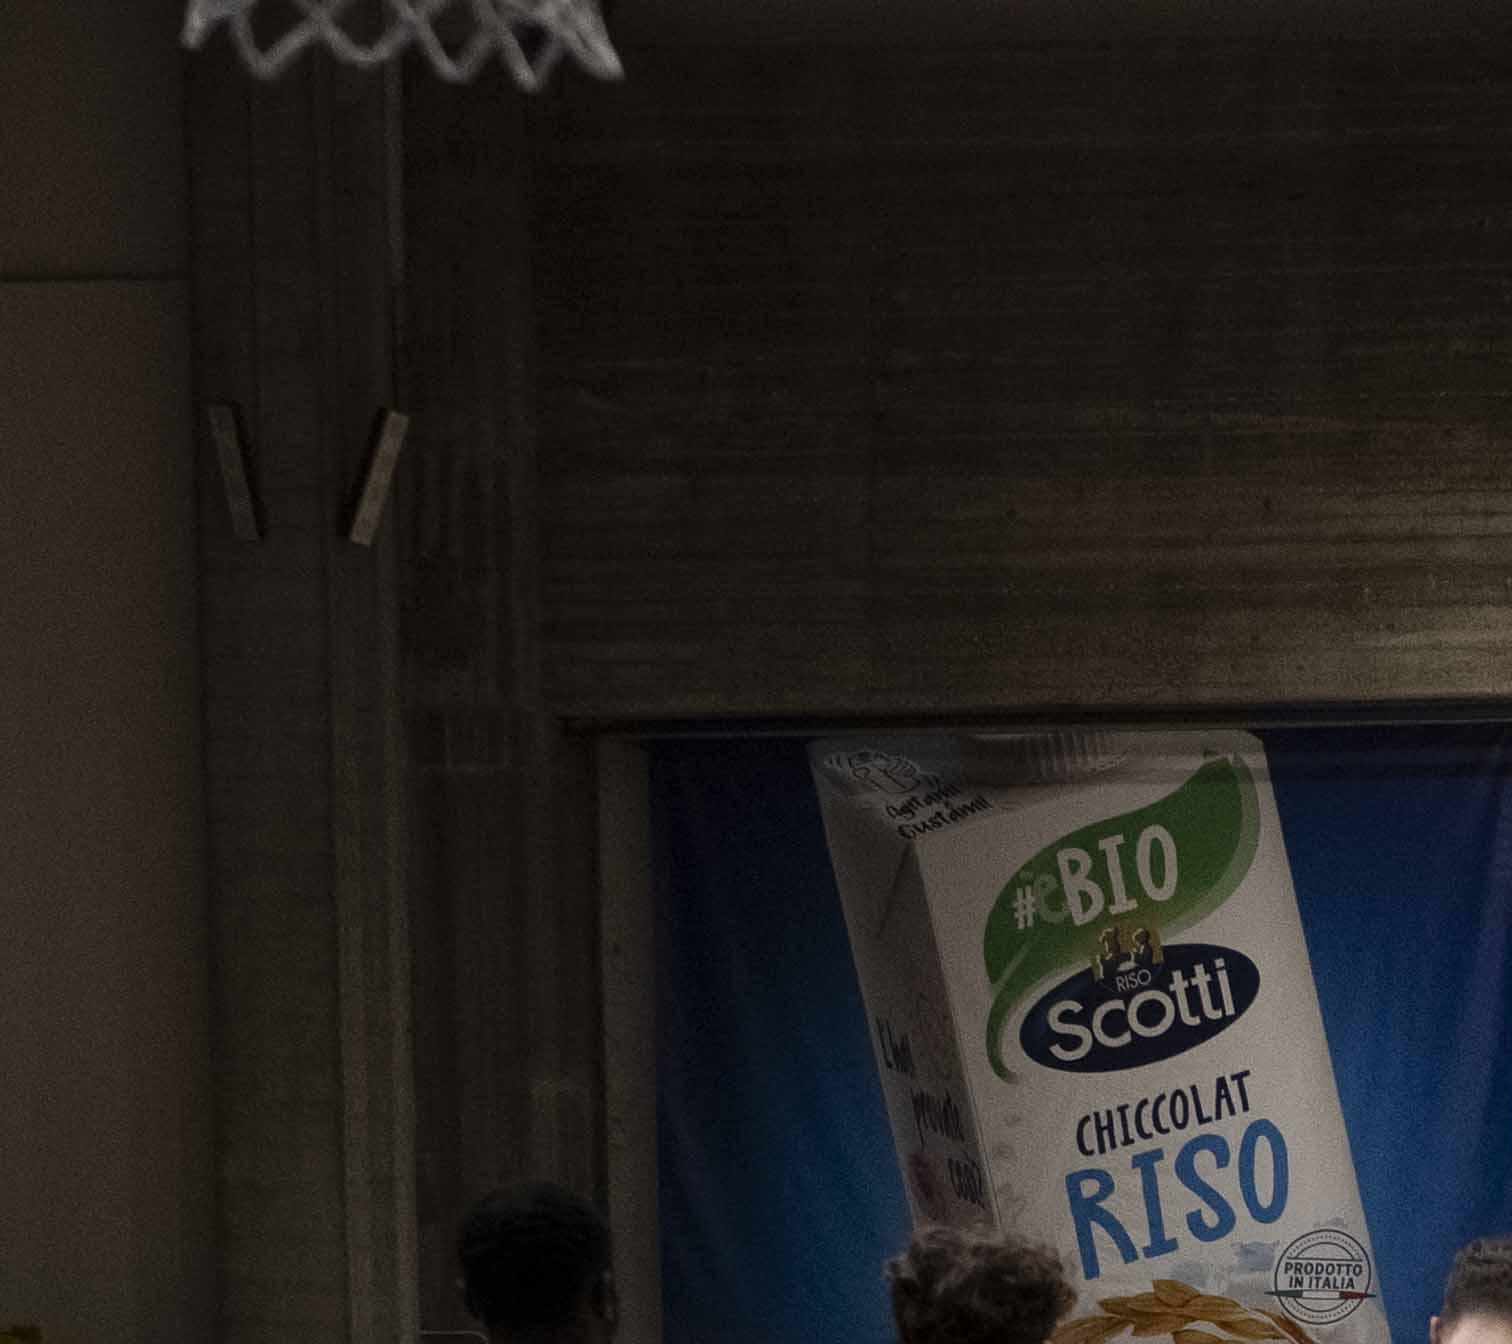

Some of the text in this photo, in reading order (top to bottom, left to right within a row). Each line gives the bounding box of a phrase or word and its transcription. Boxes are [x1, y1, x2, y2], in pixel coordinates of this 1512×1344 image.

[1115, 967, 1153, 994] RISO
[1047, 957, 1237, 1062] Scotti
[1075, 1069, 1252, 1157] CHICCOLAT
[1064, 1117, 1291, 1280] RISO
[1283, 1261, 1363, 1277] PRODOTTO
[1288, 1276, 1356, 1290] IN ITALIA
